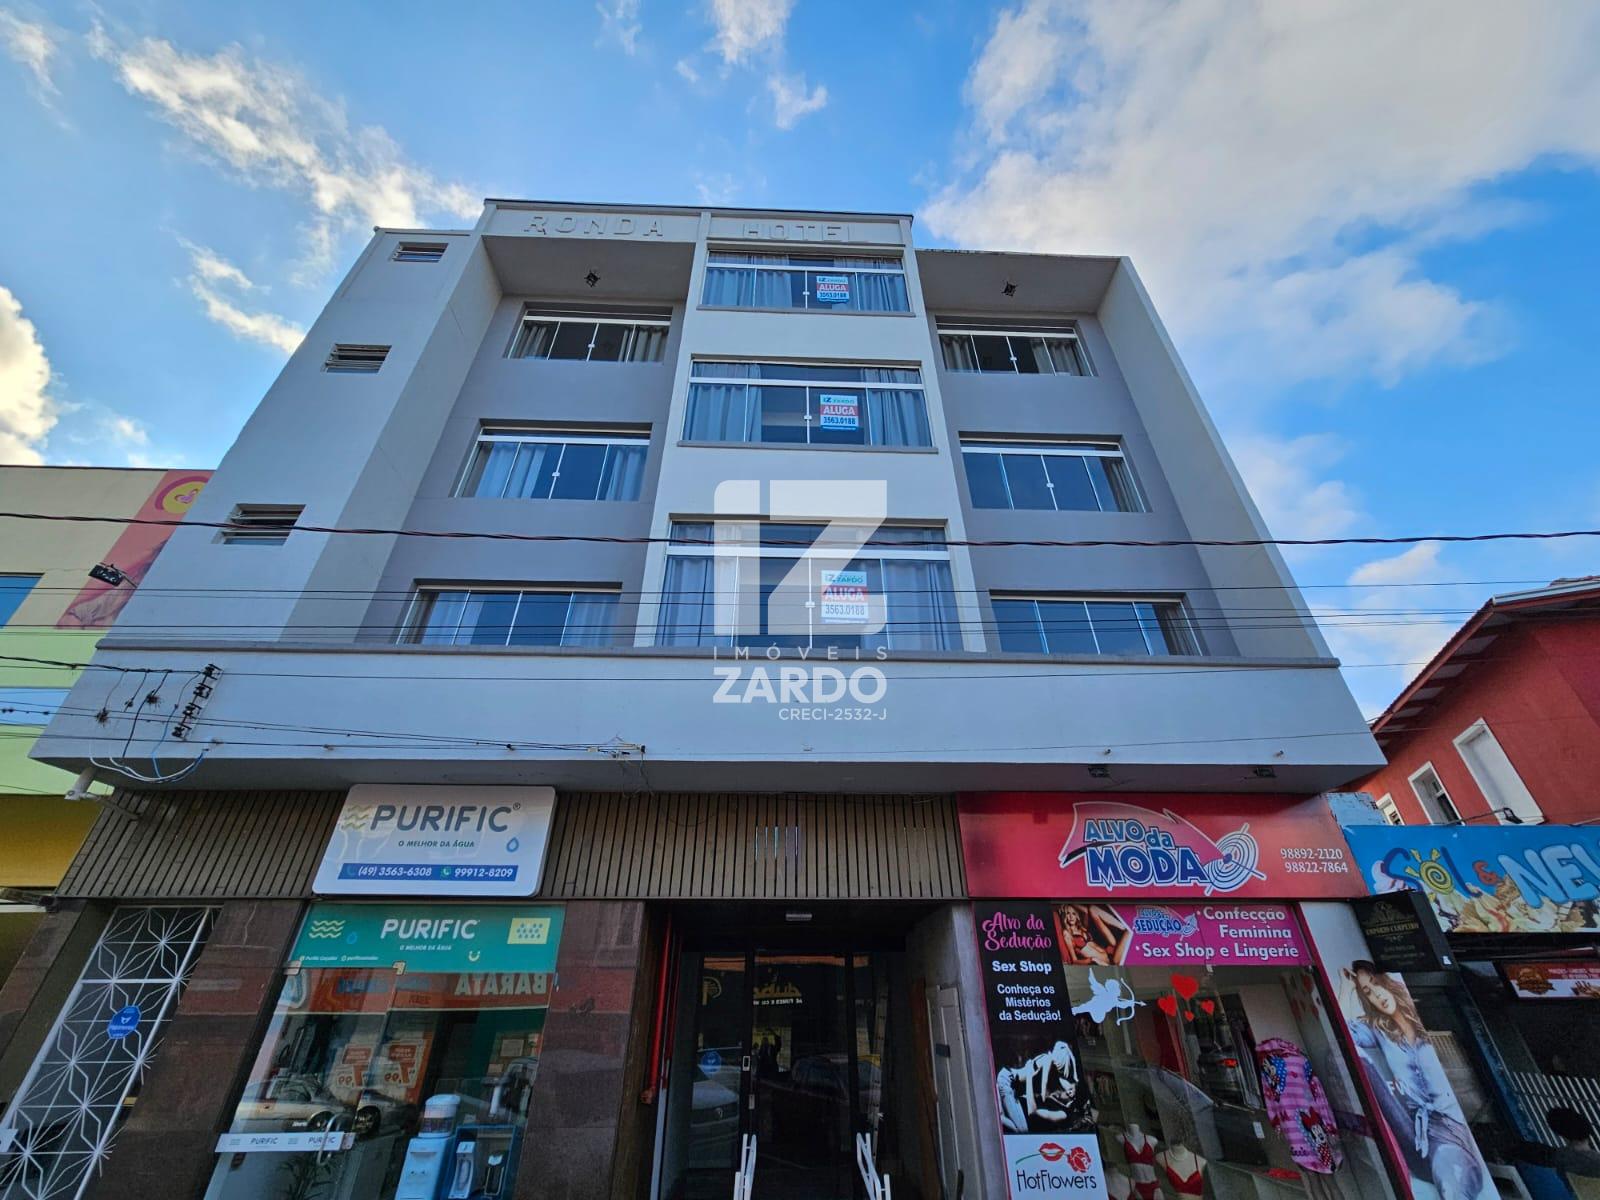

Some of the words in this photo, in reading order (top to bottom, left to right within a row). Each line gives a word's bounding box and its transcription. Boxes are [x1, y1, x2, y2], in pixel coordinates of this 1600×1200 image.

[523, 215, 664, 237] RONDA
[820, 283, 847, 291] ALUGA
[823, 405, 856, 416] ALUGA
[823, 416, 856, 425] 3563.0188
[824, 586, 865, 601] ALUGA
[825, 603, 865, 616] 3563.0188
[1085, 820, 1146, 843] ALVO
[1145, 828, 1174, 849] da
[398, 840, 405, 848] O
[406, 840, 438, 848] MELHOR
[439, 840, 451, 848] DA
[453, 838, 475, 848] ÁGUA
[1280, 848, 1343, 860] 98892-2120
[358, 865, 378, 877] (49)
[379, 866, 433, 877] 3563-6308
[454, 868, 514, 879] 99912-8209
[1088, 847, 1209, 888] MODA
[1284, 861, 1349, 874] 98822-7864
[982, 911, 1021, 932] Alvo
[1026, 913, 1045, 931] da
[1203, 906, 1286, 924] Confecção
[380, 918, 478, 940] PURIFIC
[1219, 924, 1292, 939] Feminina
[984, 930, 1052, 951] Sedução
[1142, 943, 1172, 957] Sex
[1174, 943, 1216, 960] Shop
[1219, 948, 1230, 958] e
[1234, 942, 1300, 961] Lingerie
[992, 960, 1017, 972] Sex
[1019, 960, 1053, 975] Shop
[997, 984, 1042, 996] Conheça
[1042, 985, 1055, 994] os
[1005, 997, 1052, 1008] Mistérios
[998, 1010, 1013, 1021] da
[1014, 1010, 1062, 1023] Sedução!
[250, 1137, 279, 1145] PURIFIC
[1016, 1169, 1098, 1193] HotFlowers
